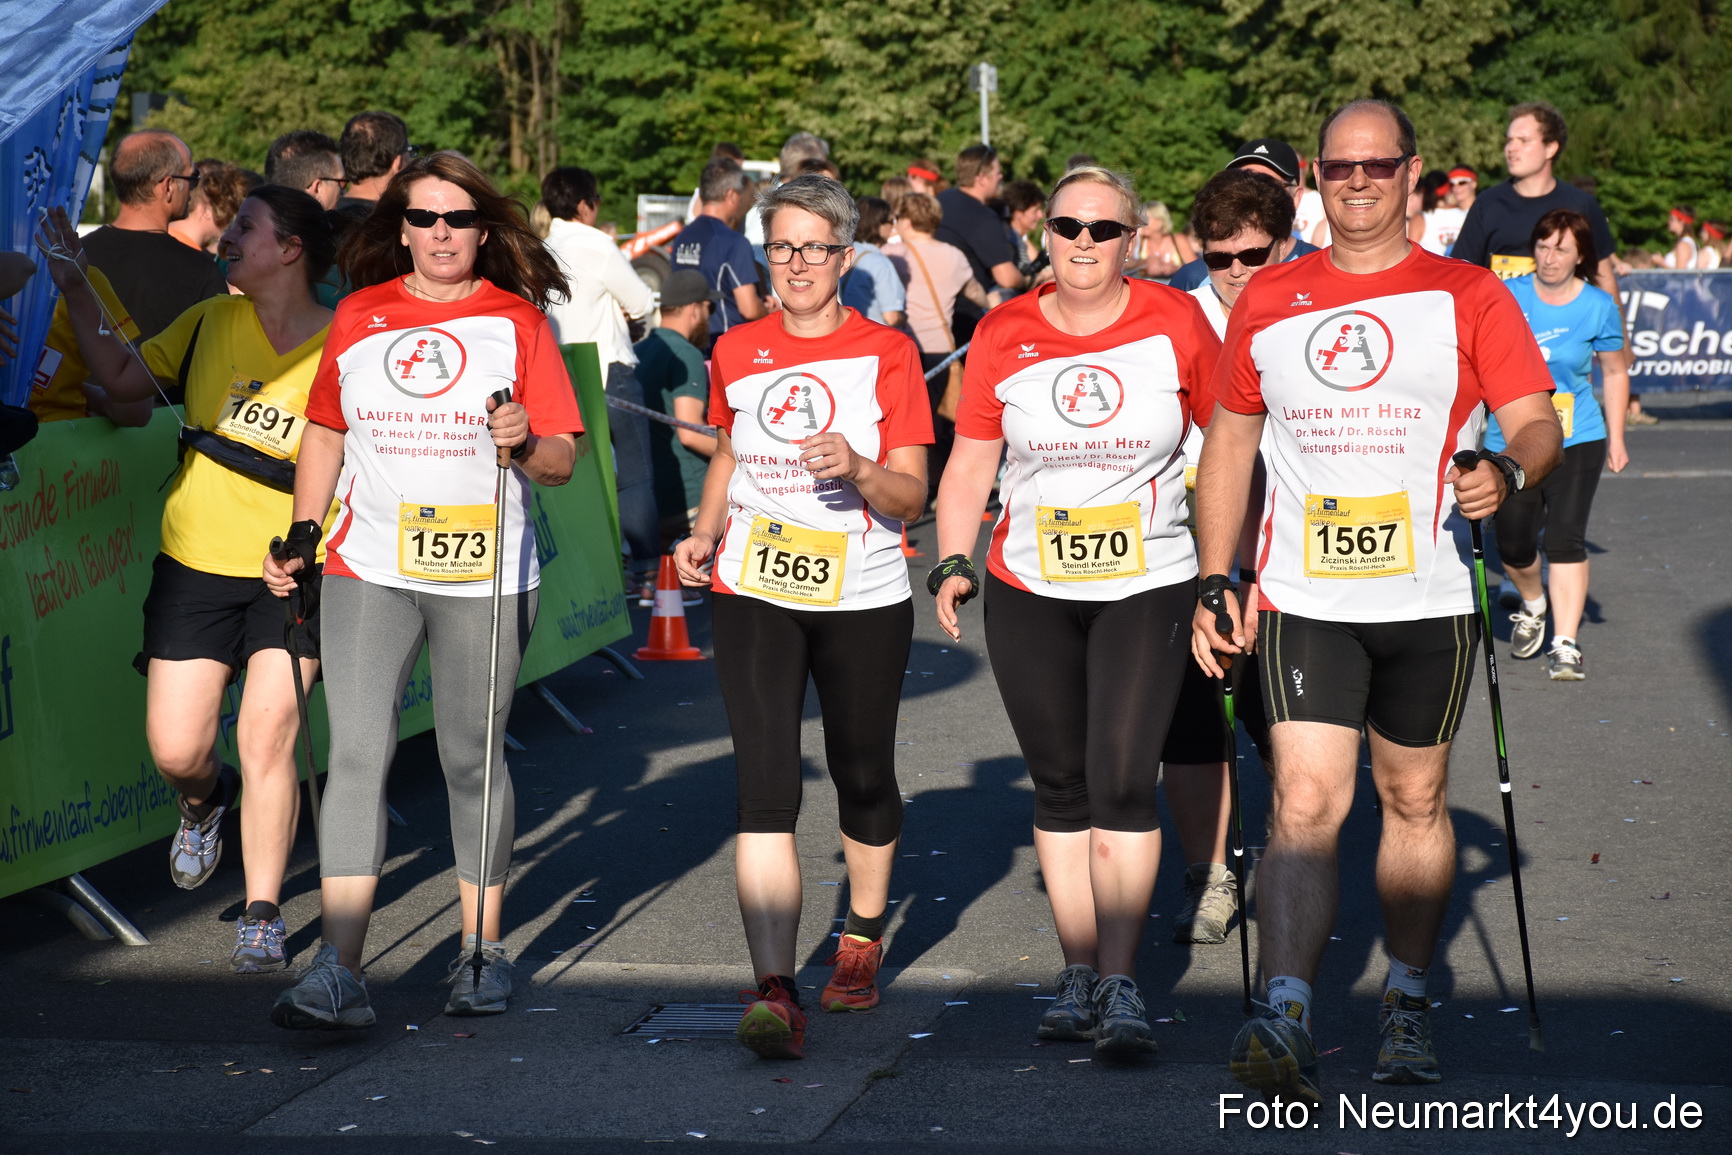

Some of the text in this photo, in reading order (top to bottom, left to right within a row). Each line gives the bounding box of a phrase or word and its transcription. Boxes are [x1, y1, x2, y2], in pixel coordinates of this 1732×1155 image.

[1017, 351, 1040, 359] erima
[1627, 360, 1732, 377] UTOMOBI
[231, 399, 296, 440] 1691
[454, 411, 489, 426] HER
[229, 421, 281, 445] Schneider Julia
[372, 429, 478, 441] Dr. Heck / Dr. Röschl
[1296, 426, 1407, 438] Dr. Heck / Dr. Röschl
[374, 443, 477, 459] Leistungsdiagnostik
[1298, 441, 1405, 455] Leistungsdiagnostik
[1042, 455, 1056, 463] Dr.
[1057, 454, 1081, 462] Heck
[1105, 452, 1137, 460] Röschl
[756, 471, 782, 480] Heck
[784, 469, 789, 480] /
[791, 468, 807, 478] Dr.
[1317, 508, 1351, 517] firmenlauf
[412, 531, 486, 559] 1573
[1050, 530, 1128, 561] 1570
[1317, 523, 1397, 555] 1567
[414, 559, 483, 568] Haubner Michaela
[756, 546, 830, 585] 1563
[1061, 559, 1121, 569] Steindl Kerstin
[1320, 555, 1396, 565] Ziczinski Andreas
[758, 574, 820, 592] Hartwig Carmen
[762, 583, 779, 592] Praxis
